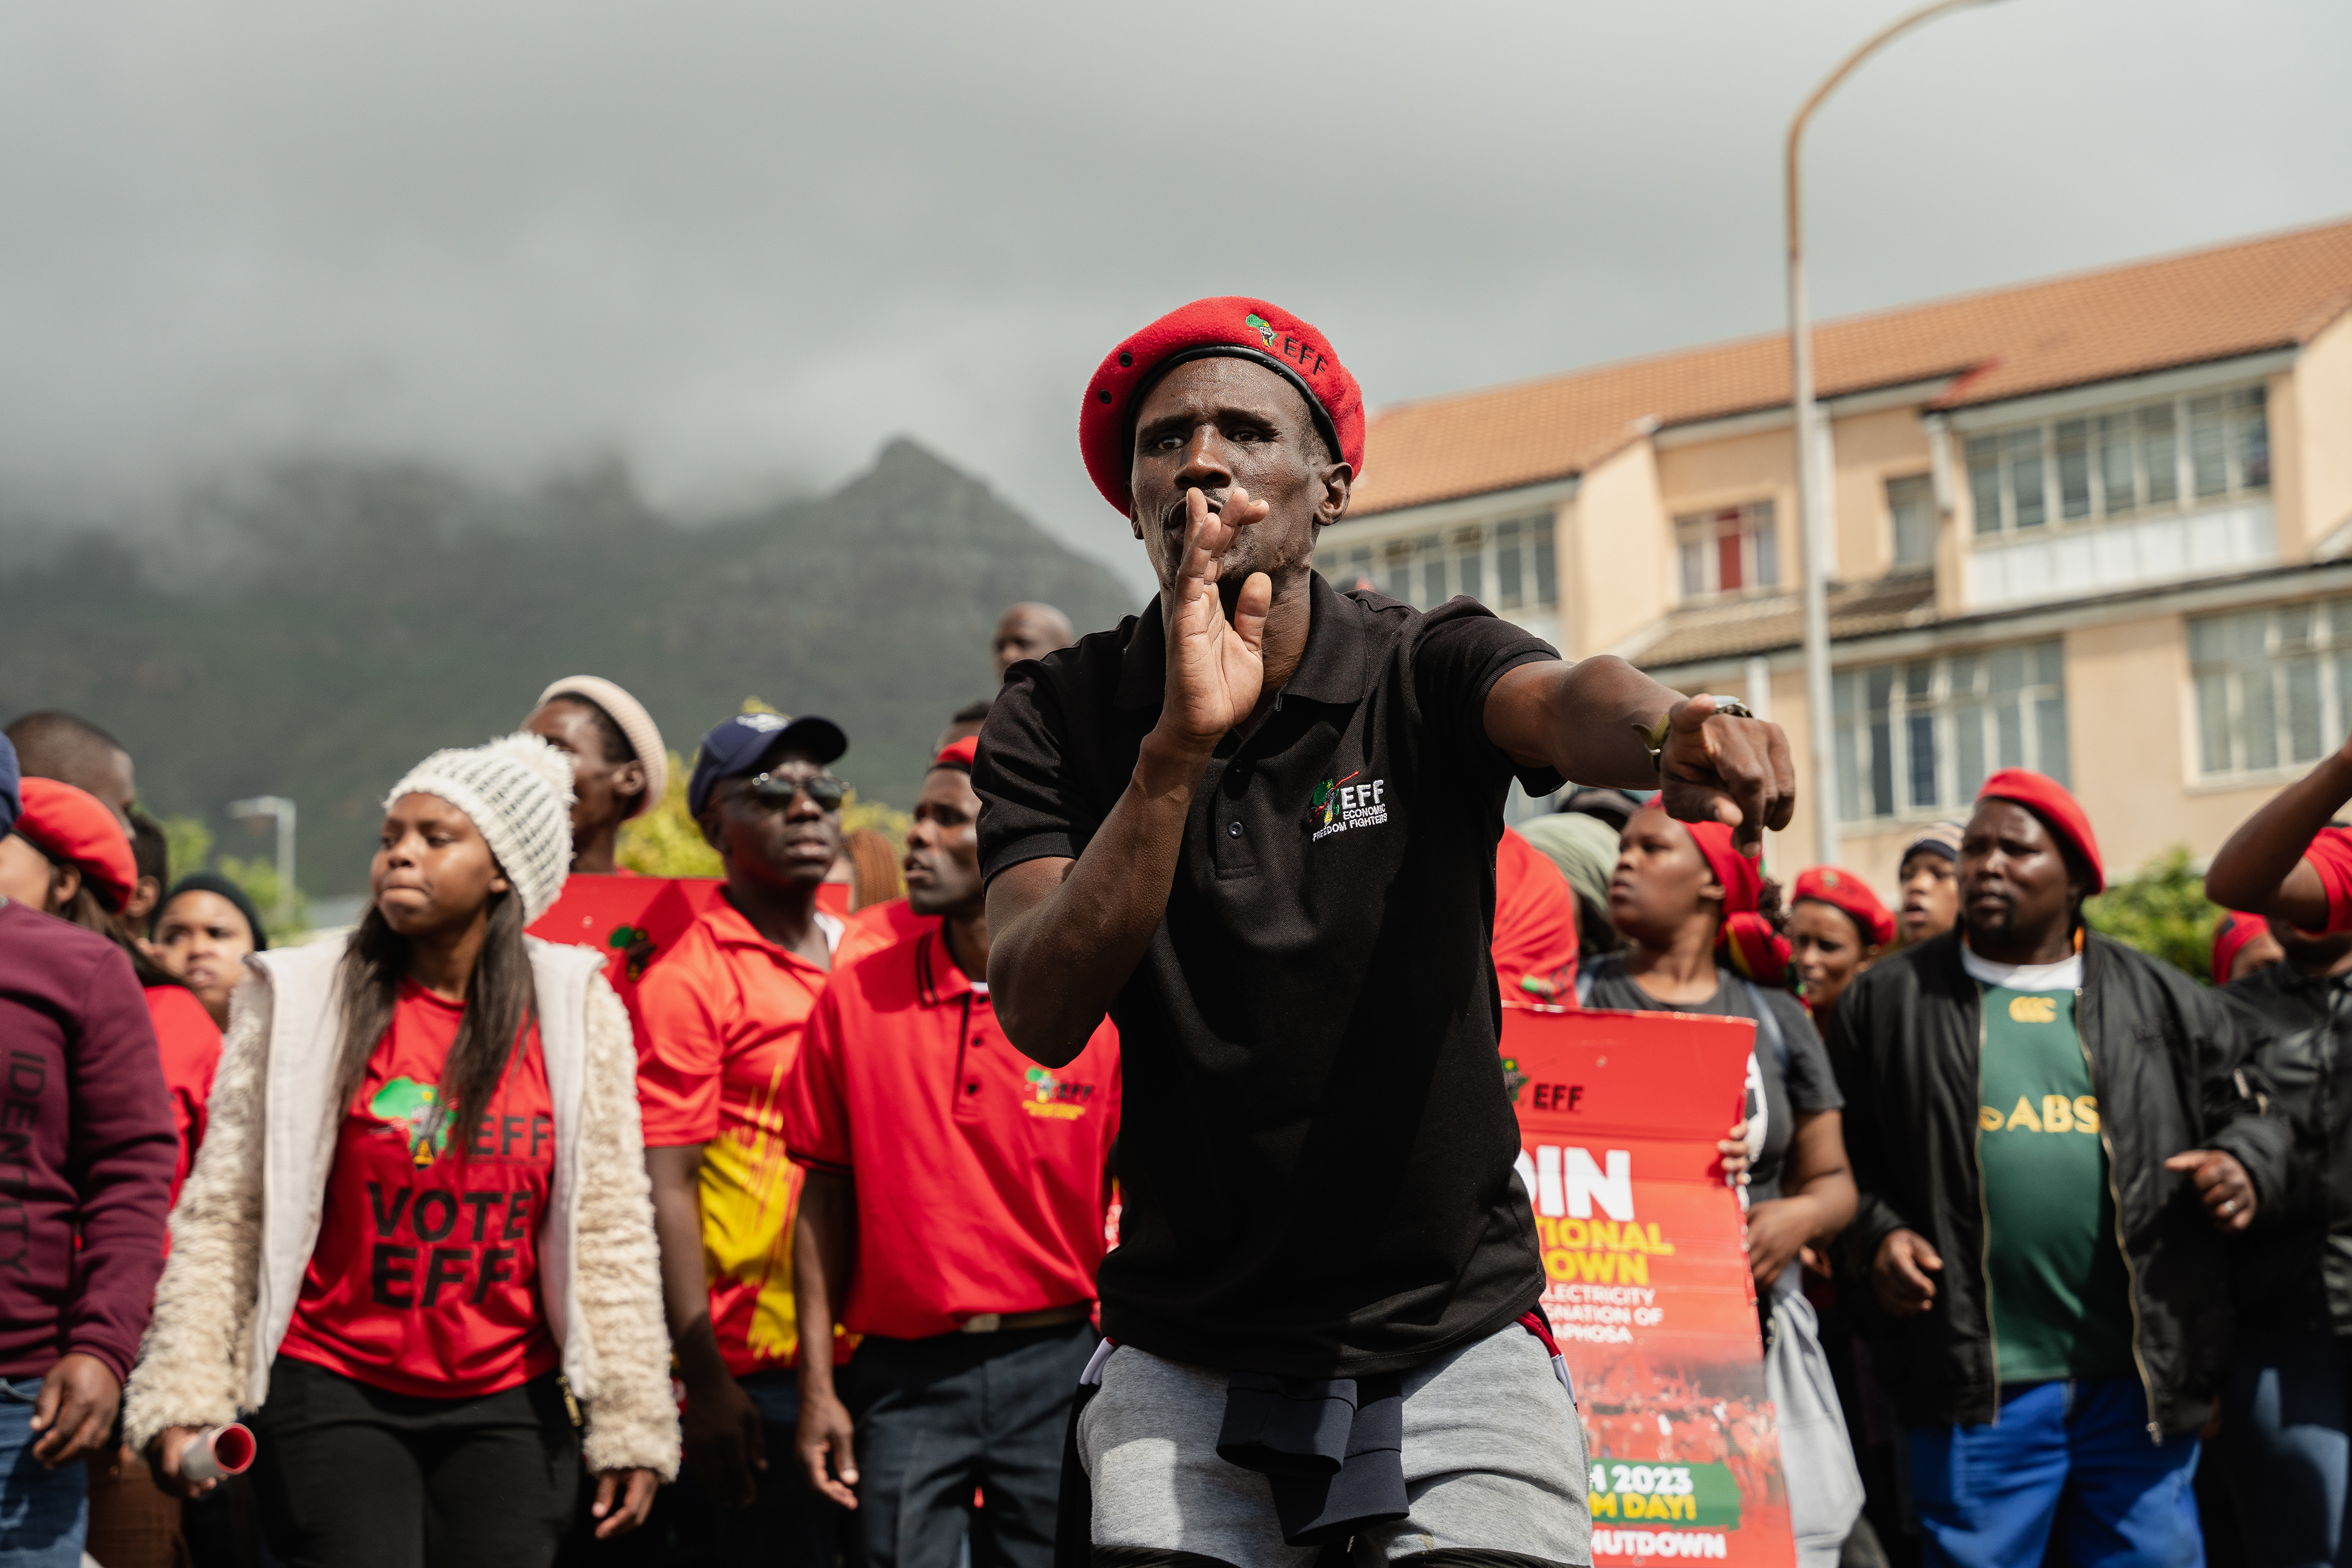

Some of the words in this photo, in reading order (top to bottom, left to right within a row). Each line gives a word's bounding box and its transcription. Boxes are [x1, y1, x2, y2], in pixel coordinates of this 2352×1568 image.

[1284, 336, 1328, 375] EFF
[1340, 779, 1384, 810] EFF
[1343, 803, 1385, 820] ECONOMIC
[1313, 821, 1347, 842] FREEDOM
[1349, 813, 1387, 828] FIGHTERS
[1534, 1084, 1585, 1112] EFF
[468, 1115, 551, 1157] EFF
[0, 1049, 47, 1277] IDENTITY
[367, 1182, 533, 1242] VOTE
[372, 1243, 516, 1309] EFF
[1541, 1247, 1649, 1286] OWN
[1539, 1282, 1656, 1307] LECTRICITY
[1634, 1306, 1665, 1327] OF
[1610, 1464, 1694, 1496] 2023
[1622, 1492, 1697, 1520] DAY!
